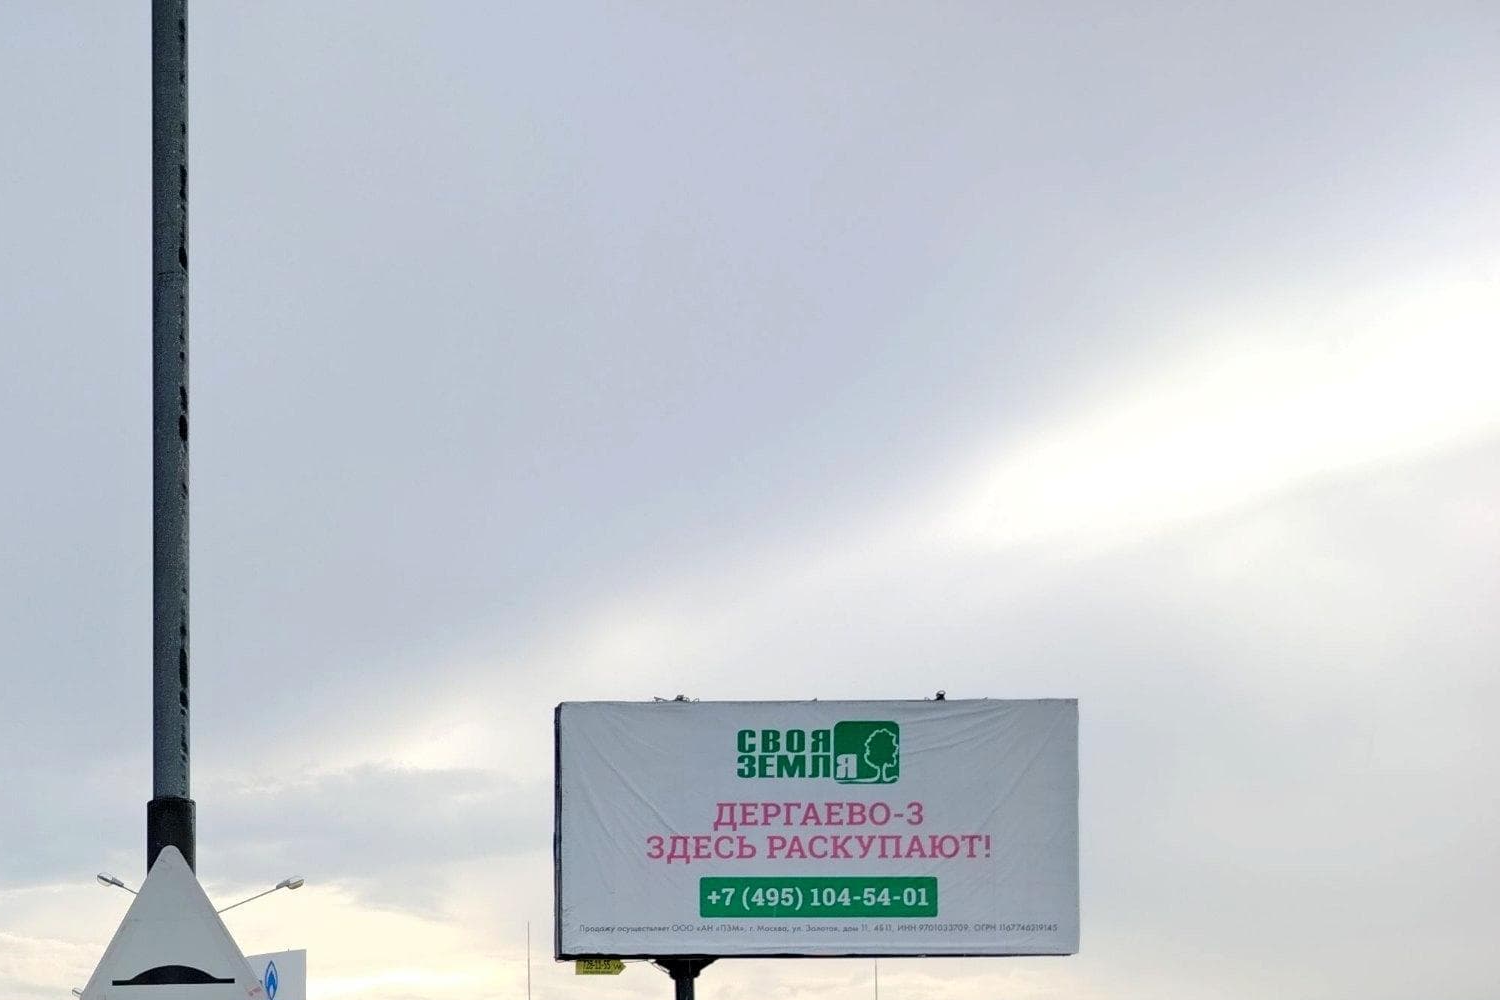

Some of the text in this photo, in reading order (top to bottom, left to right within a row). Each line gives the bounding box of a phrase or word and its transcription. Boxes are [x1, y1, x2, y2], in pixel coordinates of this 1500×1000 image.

[737, 729, 831, 753] СВОЯ
[737, 754, 858, 778] ЗЕМЛЯ
[713, 802, 924, 831] ДЕРГАЕВО-3
[647, 834, 991, 864] ЗДЕСЬ РАСКУПАЮТ!
[707, 886, 929, 910] +7 (495) 104-54-01
[579, 924, 616, 935] Продажу
[672, 924, 694, 933] ООО
[757, 924, 789, 934] Москва,
[897, 924, 917, 932] ИНН
[973, 923, 997, 932] ОГРН
